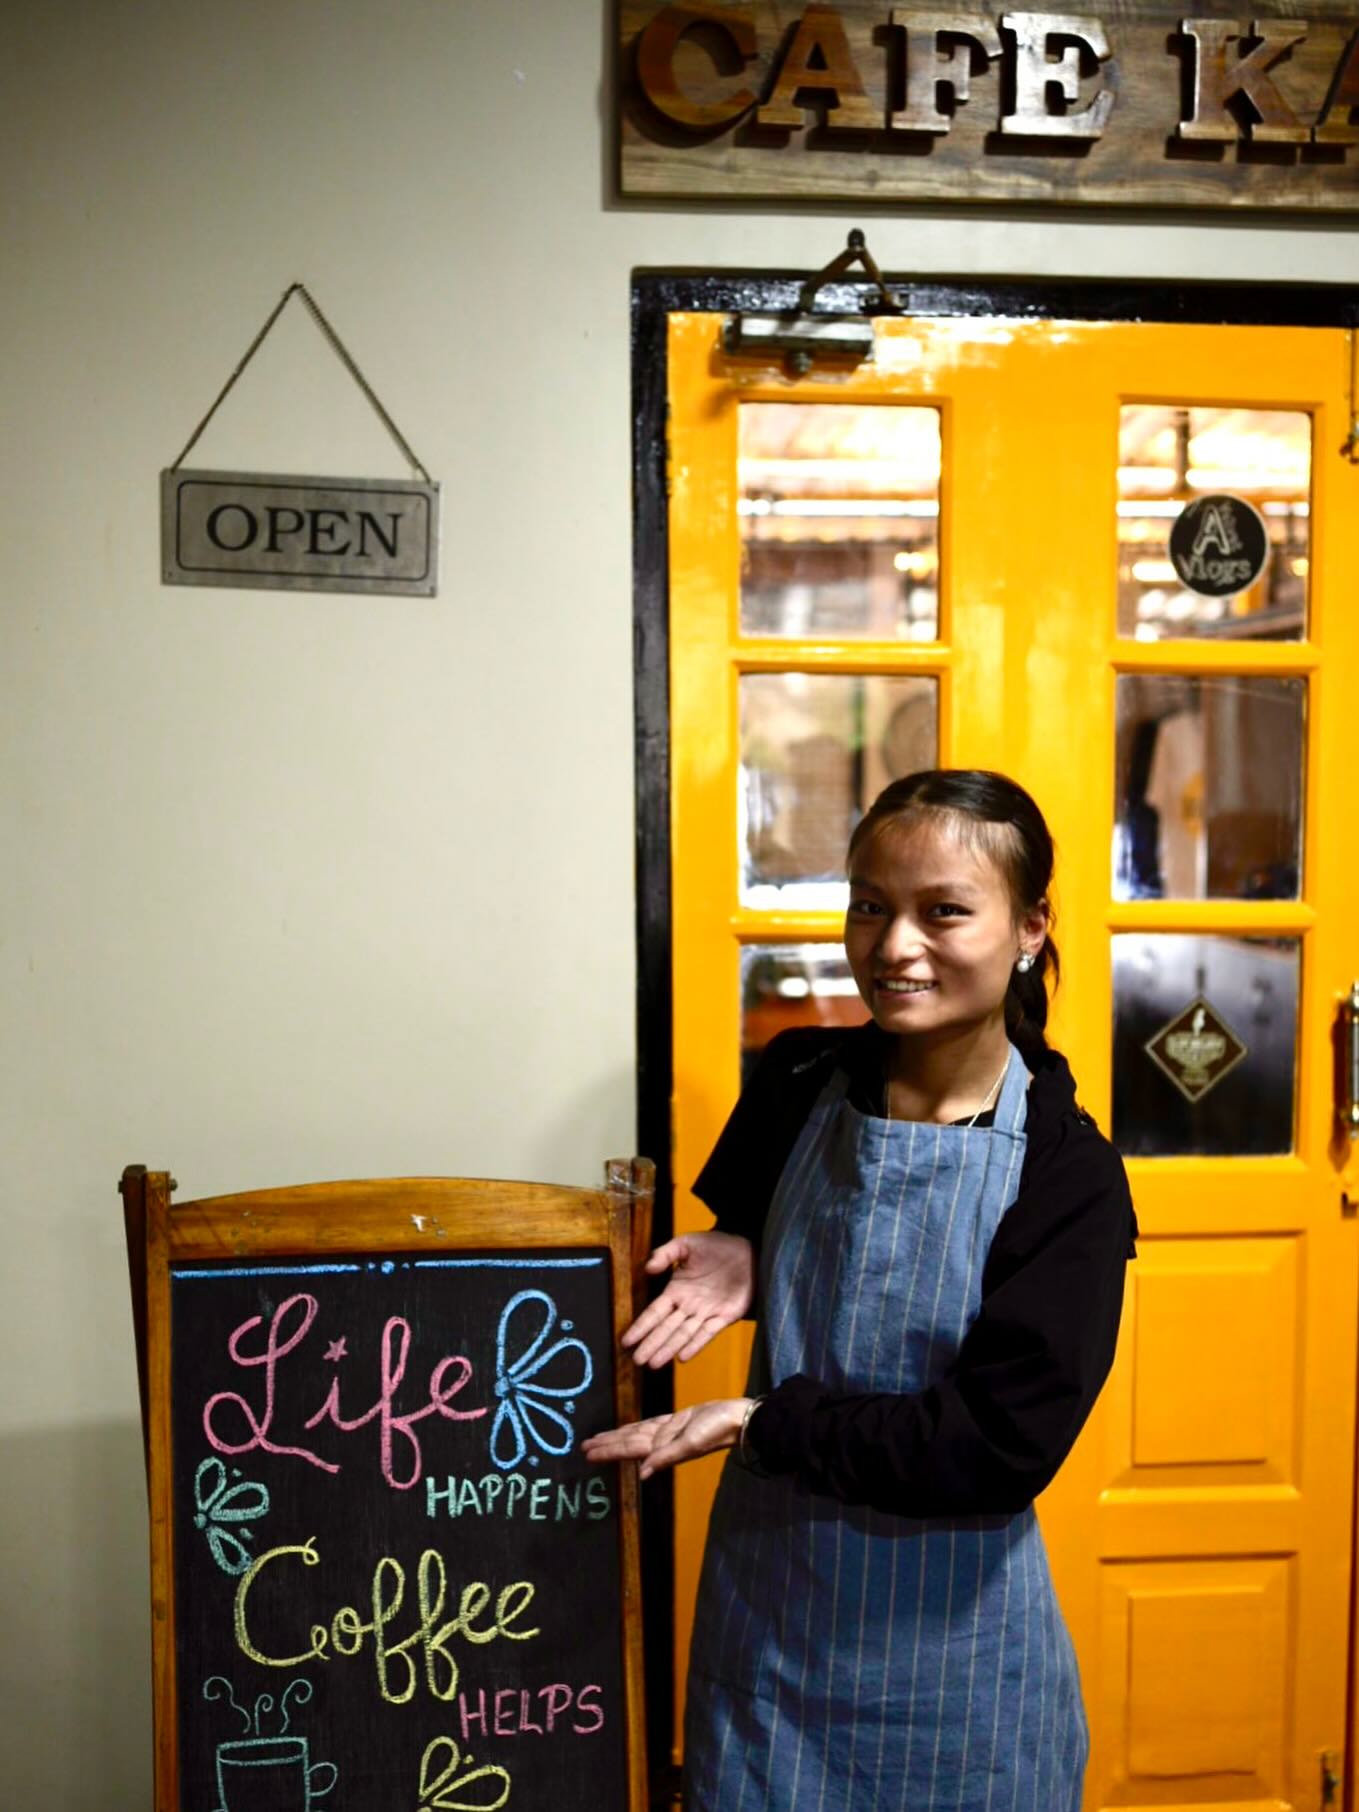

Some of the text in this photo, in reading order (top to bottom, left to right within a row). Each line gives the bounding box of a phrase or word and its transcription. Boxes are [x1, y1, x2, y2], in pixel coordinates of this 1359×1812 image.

[637, 4, 1111, 137] CAFE
[206, 503, 403, 558] OPEN
[203, 1293, 488, 1490] Life
[425, 1475, 611, 1521] HAPPENS
[234, 1536, 541, 1704] Coffee
[458, 1684, 604, 1738] HELPS
